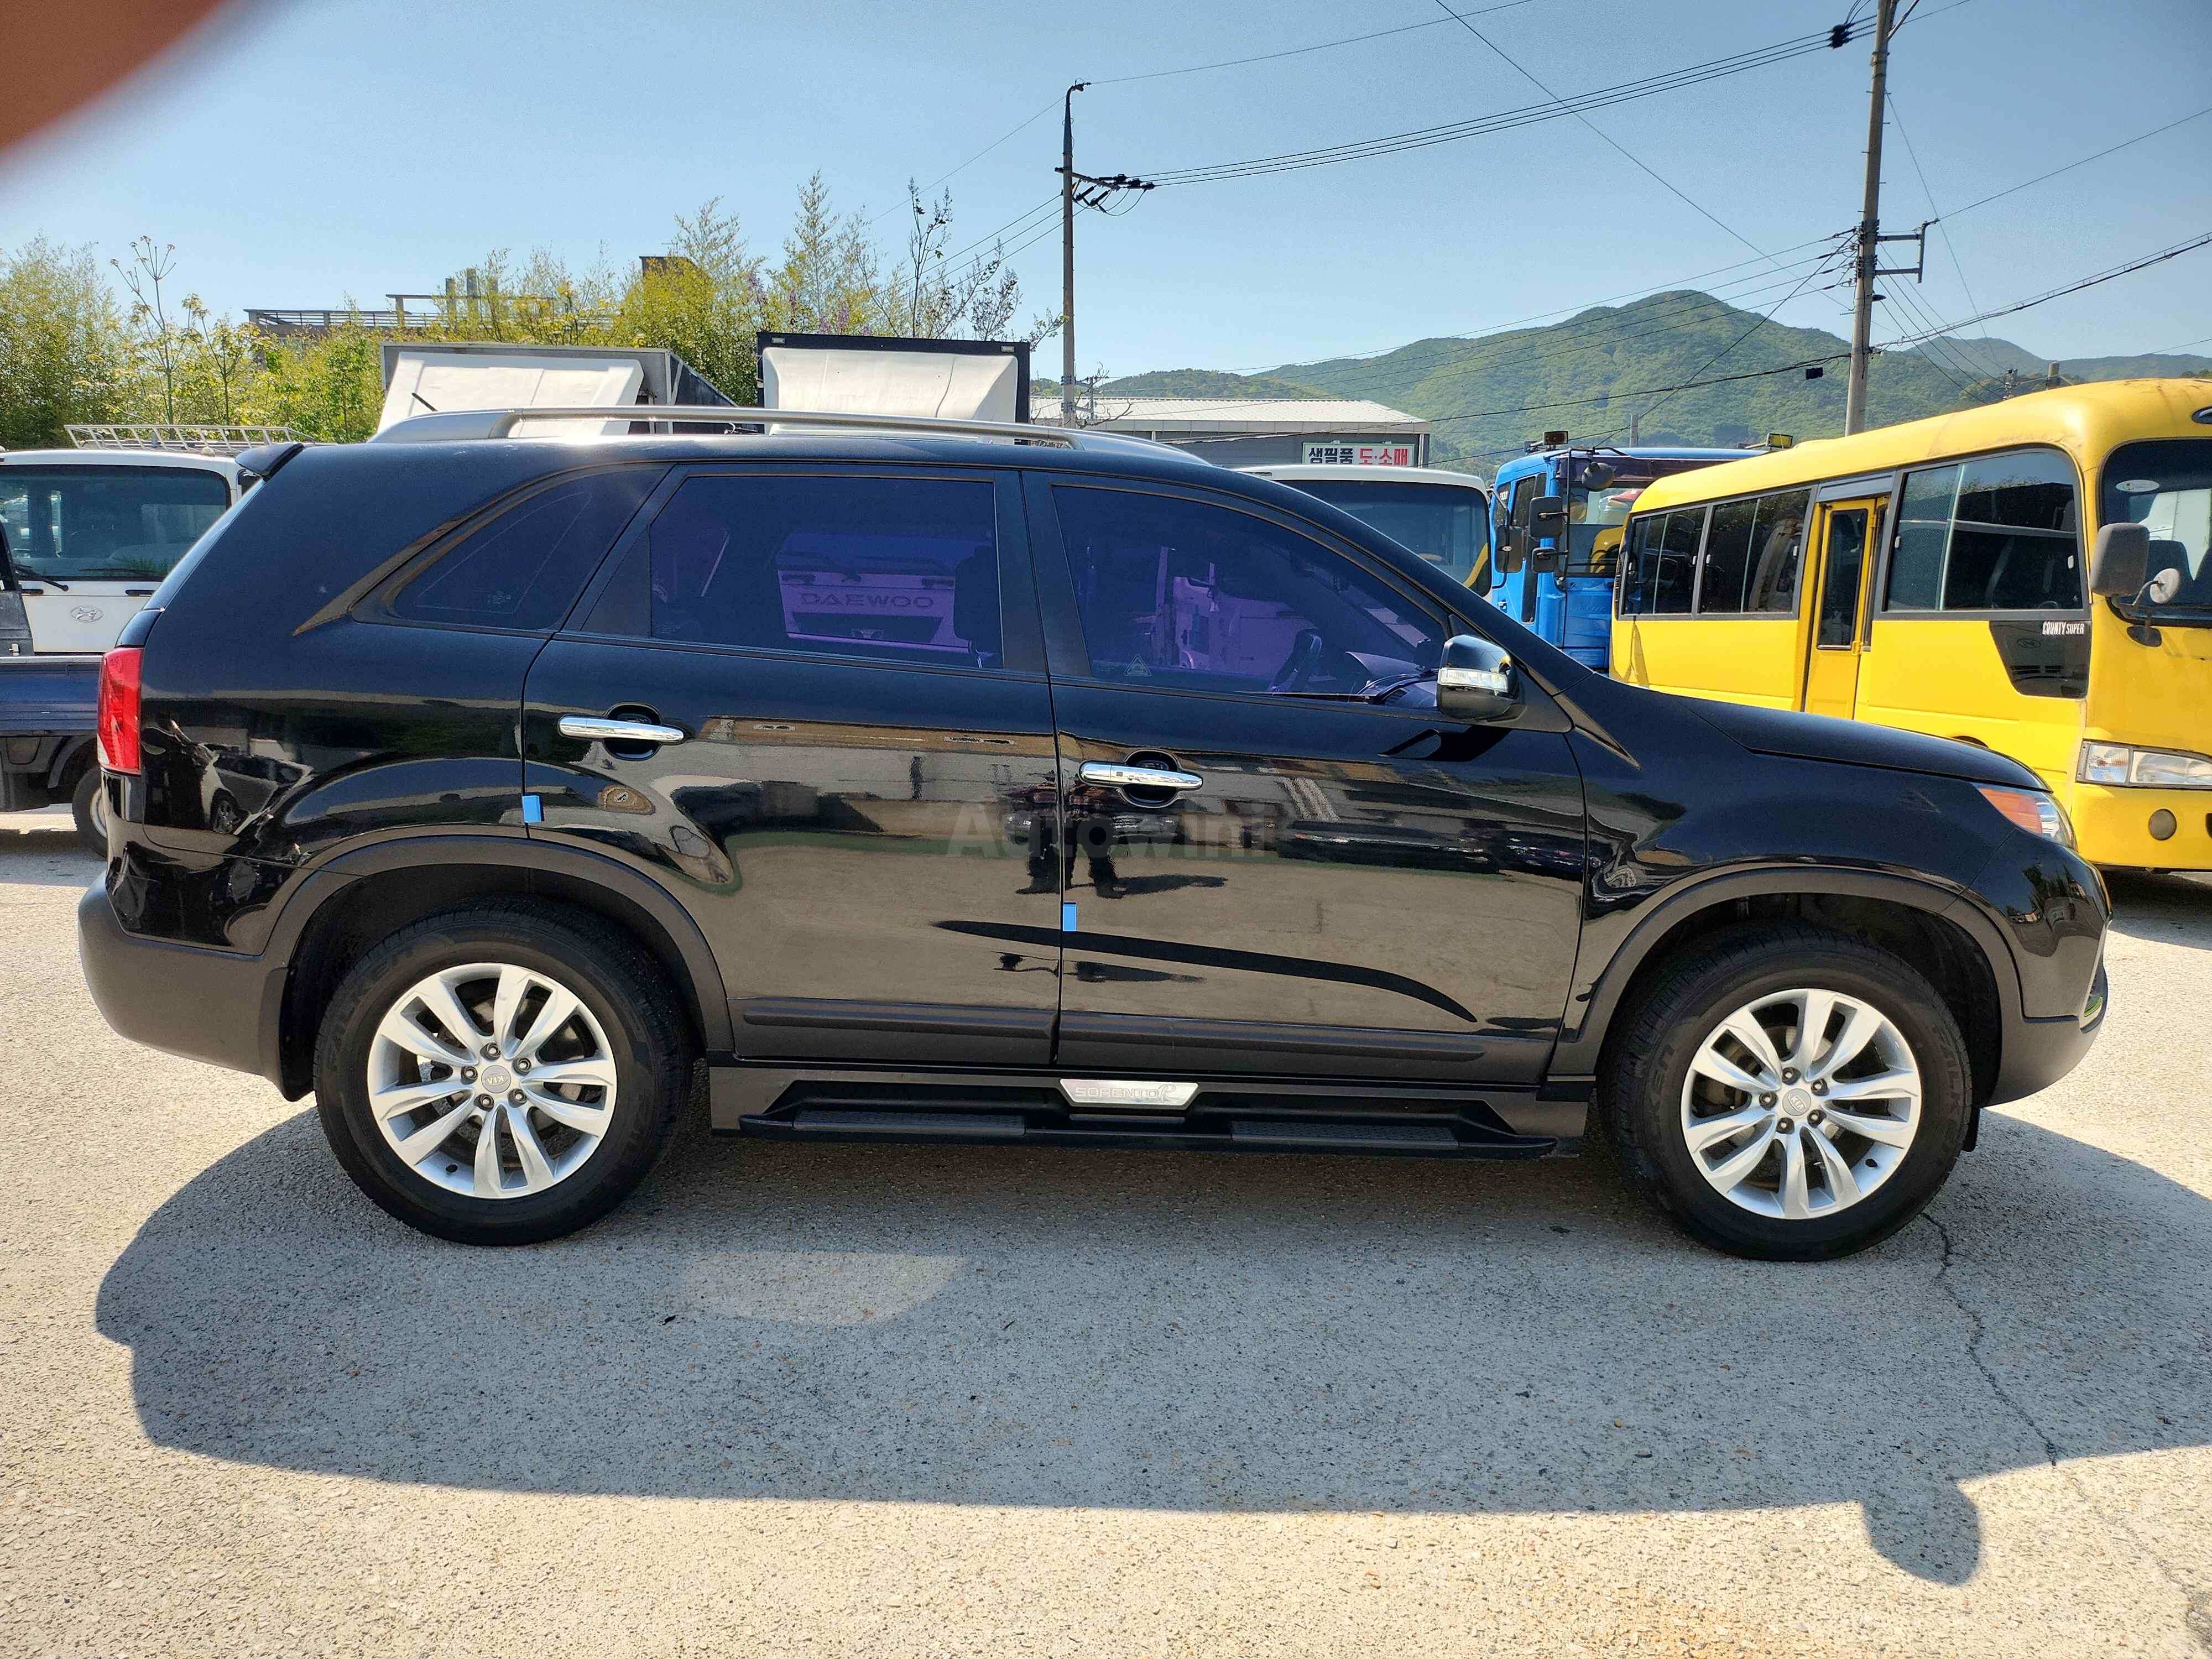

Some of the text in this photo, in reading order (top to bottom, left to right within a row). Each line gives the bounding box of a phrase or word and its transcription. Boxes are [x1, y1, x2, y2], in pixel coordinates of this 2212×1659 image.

[1308, 447, 1353, 465] 생필품
[801, 593, 934, 608] DAEWOO
[2042, 621, 2084, 635] COUNTY SUPER
[487, 1075, 504, 1084] KIA
[1074, 1087, 1159, 1098] SORENTO
[1791, 1096, 1804, 1109] KIA
